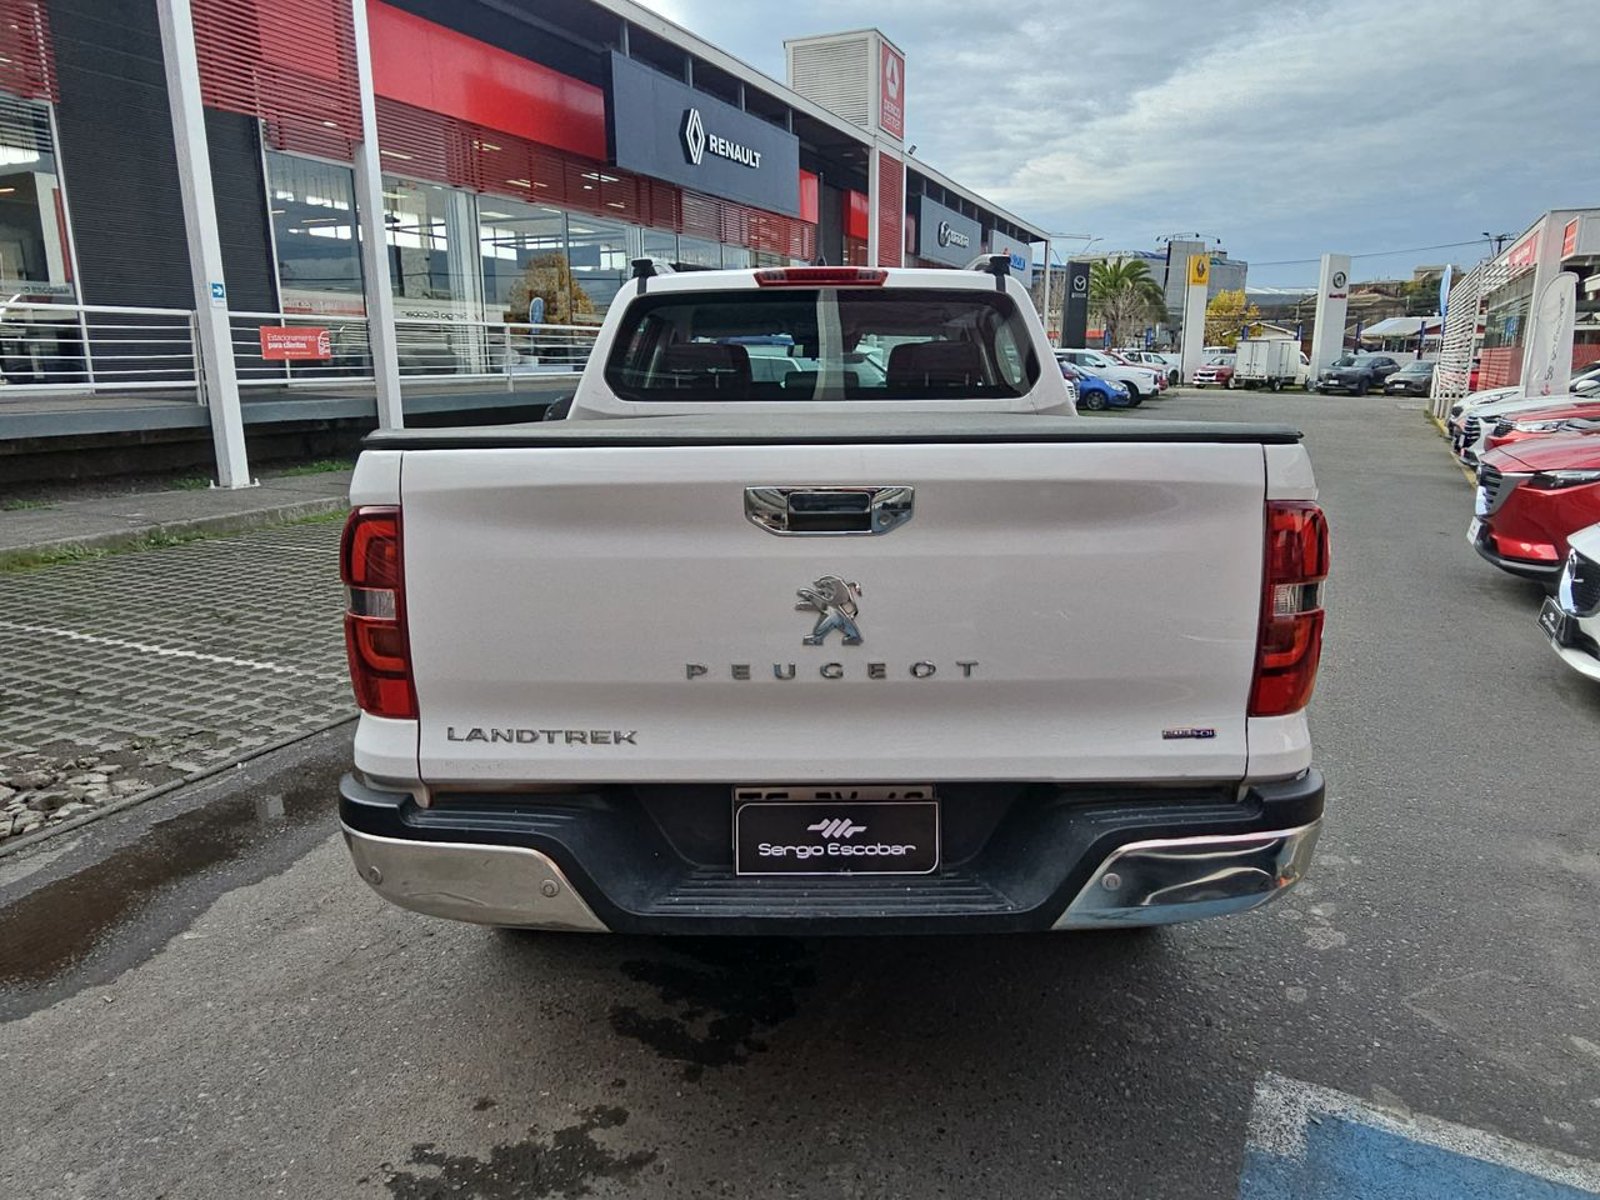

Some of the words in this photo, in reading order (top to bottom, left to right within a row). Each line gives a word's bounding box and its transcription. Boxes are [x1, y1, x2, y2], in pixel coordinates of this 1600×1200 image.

[709, 133, 761, 169] RENAULT
[685, 659, 980, 681] PEUGEOT
[447, 726, 638, 745] LANDTREK
[758, 842, 825, 859] Sergio
[827, 841, 916, 856] Escobar
